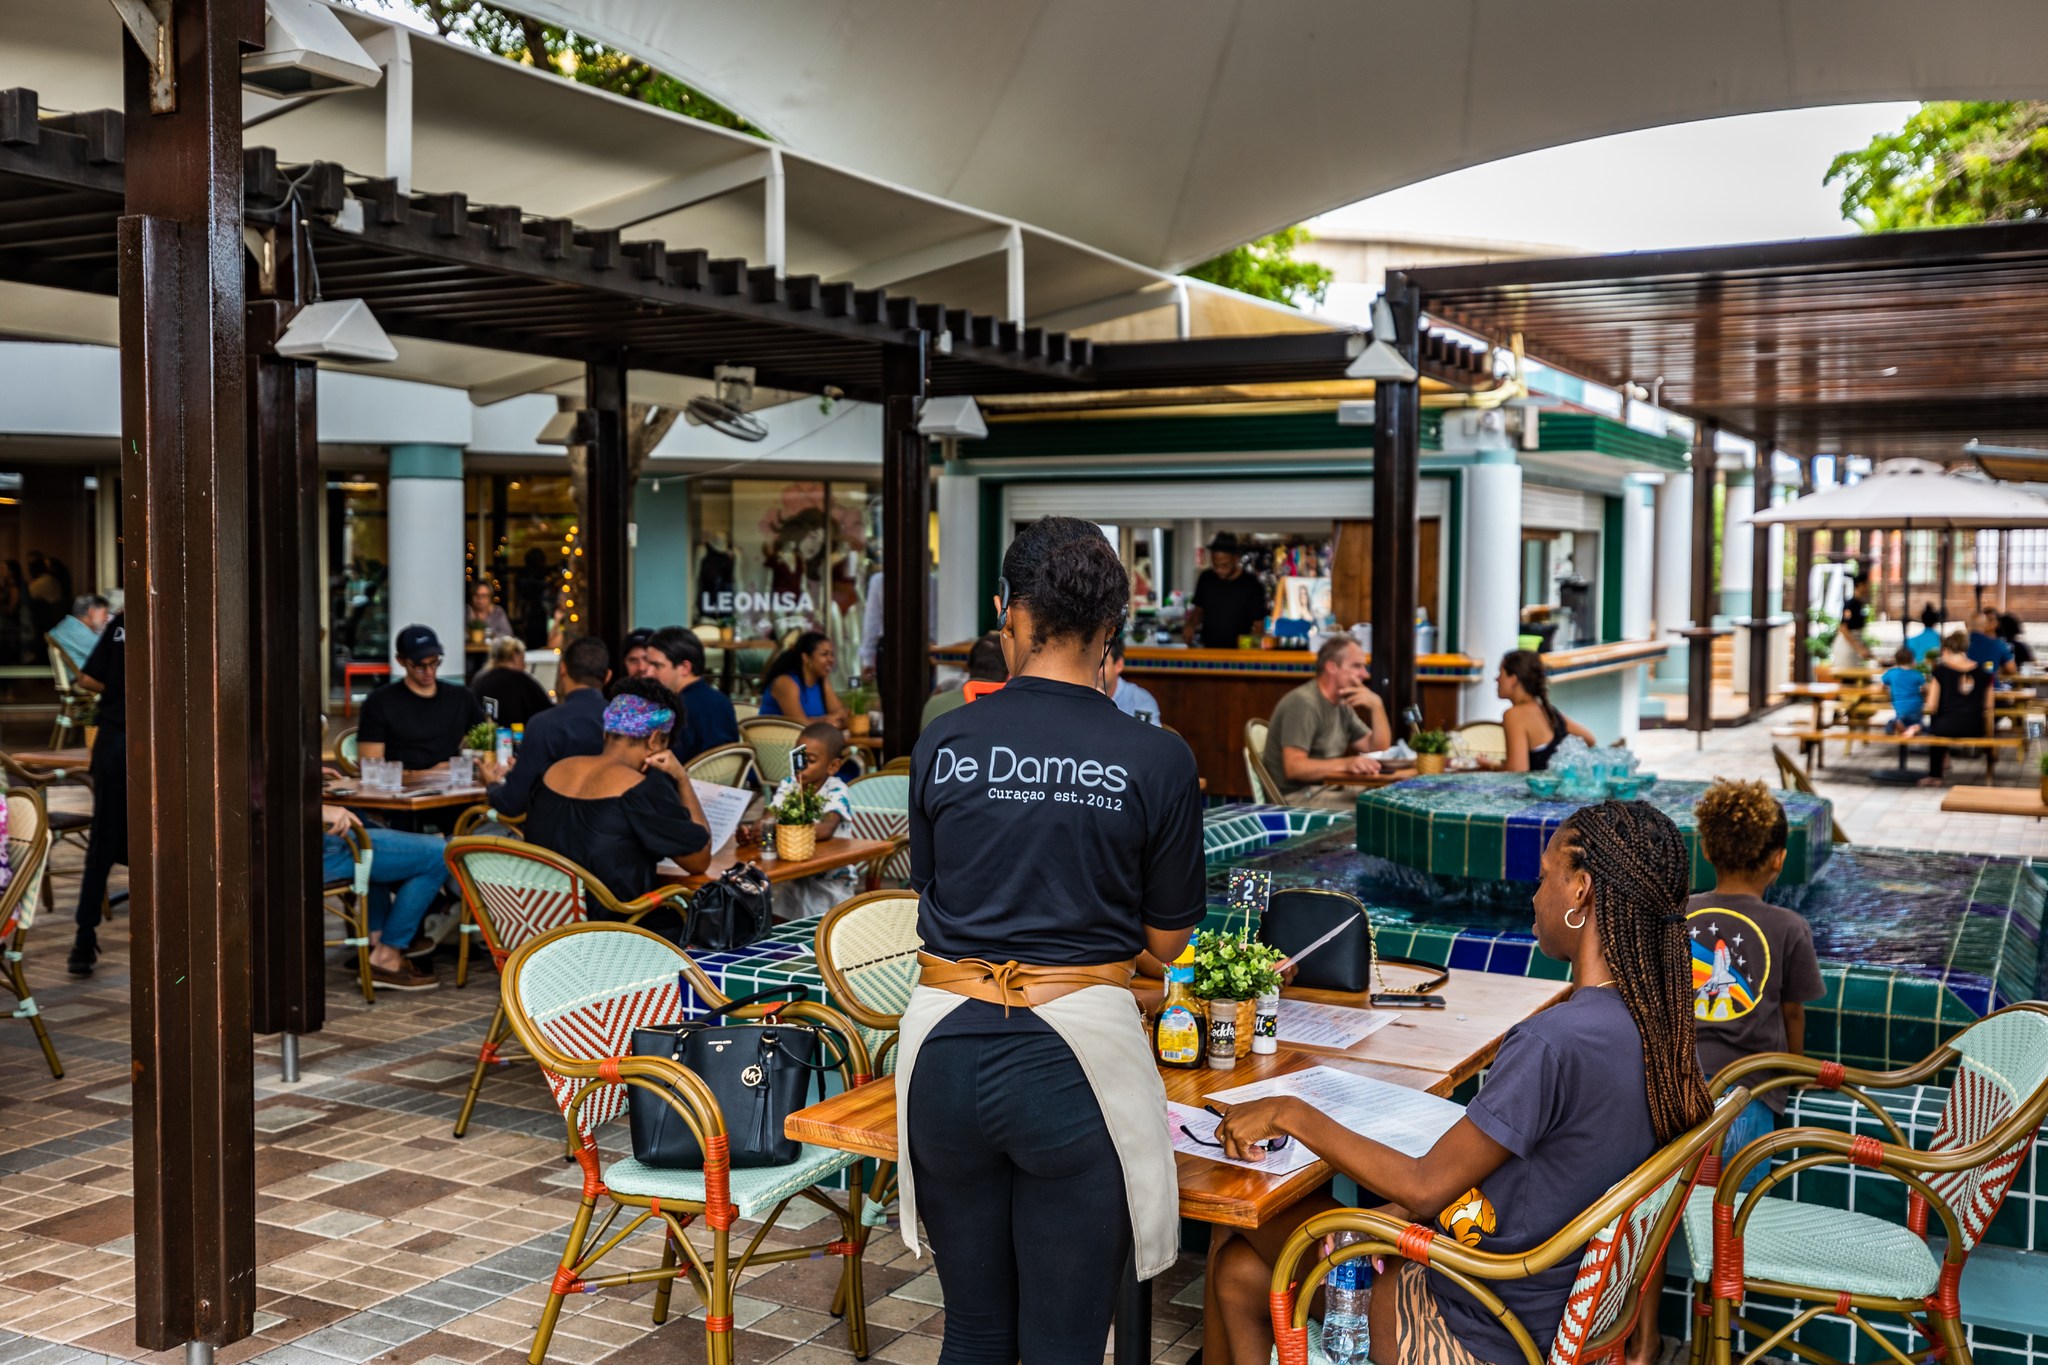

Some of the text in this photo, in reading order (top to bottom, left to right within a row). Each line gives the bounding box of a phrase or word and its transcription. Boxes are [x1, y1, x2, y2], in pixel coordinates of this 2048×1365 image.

[702, 590, 814, 612] LEONISA
[113, 626, 126, 643] D
[934, 746, 1128, 793] De Dames
[988, 787, 1123, 811] Curaçao est.2012
[1243, 879, 1255, 901] 2
[743, 1068, 760, 1084] MK
